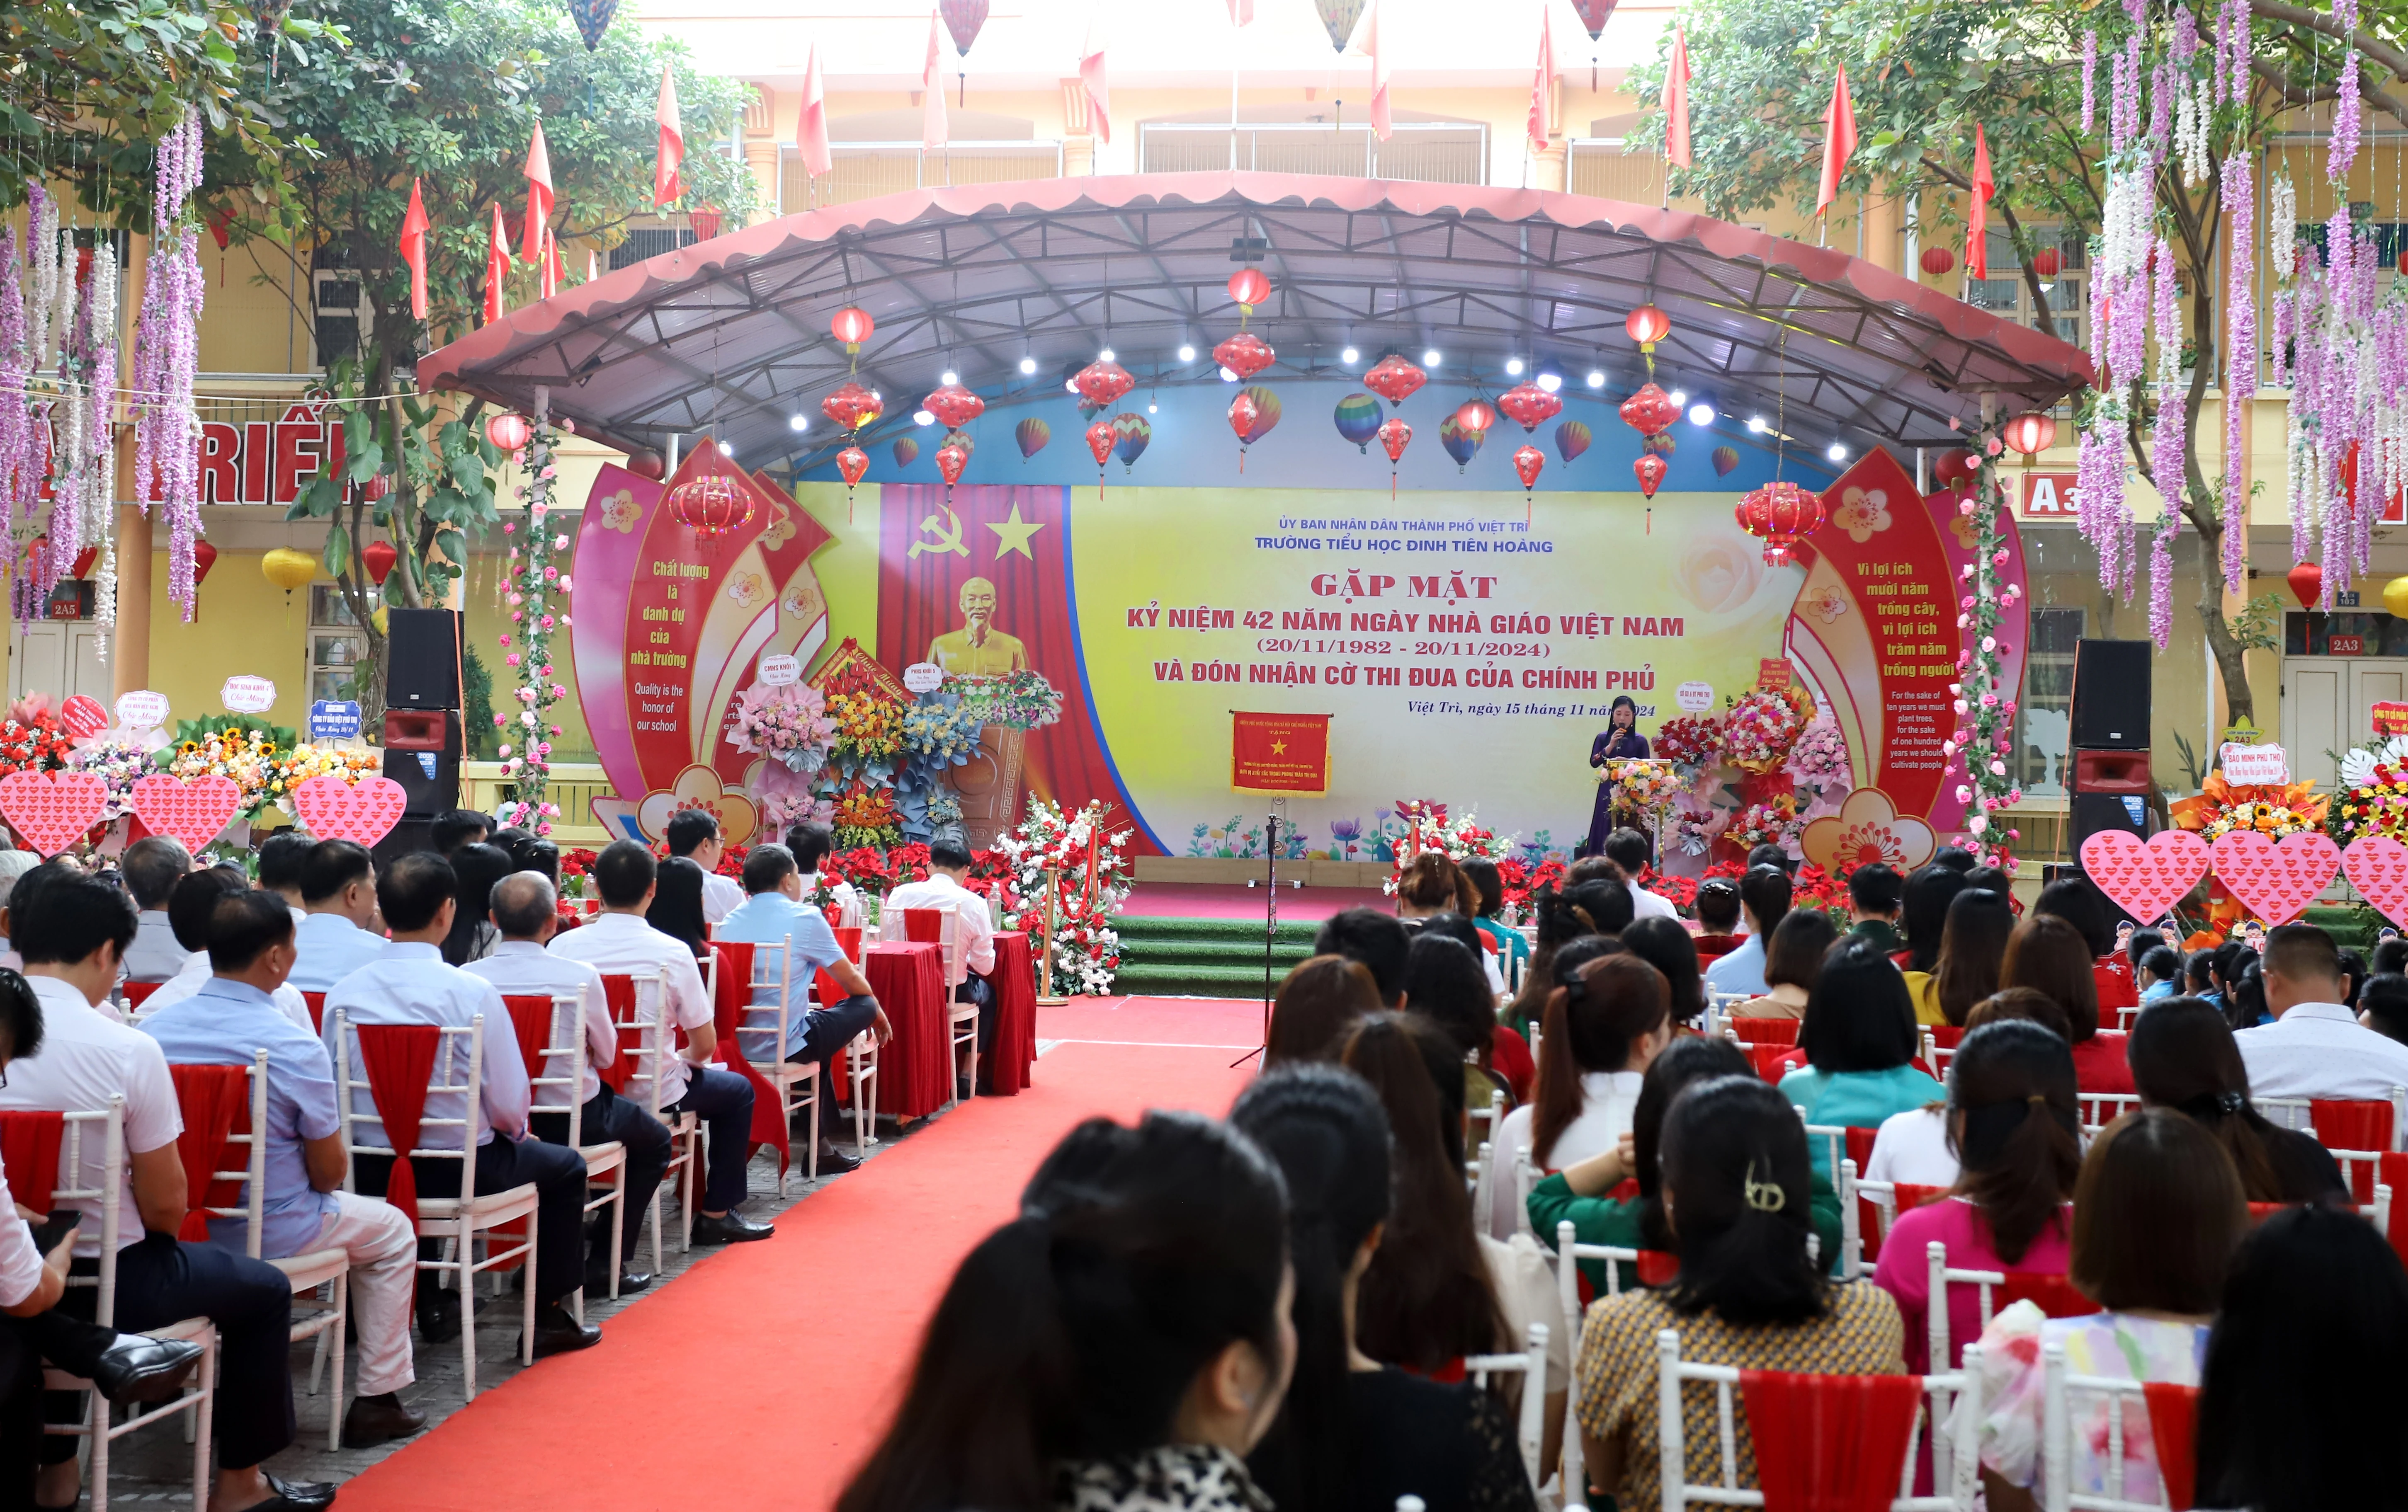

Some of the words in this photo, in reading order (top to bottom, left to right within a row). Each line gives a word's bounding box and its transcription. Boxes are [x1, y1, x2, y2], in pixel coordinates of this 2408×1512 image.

[1279, 515, 1297, 529] ỦY
[1301, 519, 1326, 529] BAN
[1330, 518, 1367, 530] NHÂN
[1370, 519, 1398, 531] DÂN
[1402, 519, 1444, 531] THÀNH
[1449, 518, 1475, 532] PHỐ
[1478, 520, 1505, 534] VIỆT
[1509, 520, 1528, 532] TRÌ
[1255, 535, 1321, 550] TRƯỜNG
[1326, 533, 1362, 550] TIỂU
[1368, 539, 1401, 554] HỌC
[1406, 540, 1447, 552] ĐINH
[1452, 538, 1488, 552] TIÊN
[1493, 538, 1553, 552] HOÀNG
[653, 559, 677, 577] Chất
[680, 562, 709, 580] lượng
[1857, 562, 1869, 576] Vì
[1873, 562, 1889, 578] lợi
[1893, 562, 1913, 575] ích
[668, 584, 677, 599] là
[1311, 568, 1396, 604] GẶP
[1407, 570, 1497, 606] MẶT
[1867, 581, 1898, 596] mười
[1901, 582, 1929, 595] năm
[54, 604, 75, 615] 2A5
[643, 606, 669, 621] danh
[672, 607, 685, 625] dự
[1877, 600, 1910, 617] trồng
[1914, 602, 1940, 616] cây,
[1127, 601, 1160, 628] KỶ
[1168, 605, 1234, 632] NIỆM
[1243, 611, 1274, 629] 42
[1282, 608, 1341, 631] NĂM
[1350, 610, 1420, 632] NGÀY
[1428, 611, 1481, 633] NHÀ
[1490, 611, 1551, 634] GIÁO
[1560, 612, 1614, 639] VIỆT
[1623, 617, 1684, 636] NAM
[650, 628, 669, 644] của
[1882, 622, 1893, 635] vì
[1898, 622, 1913, 638] lợi
[1918, 622, 1937, 635] ích
[1257, 638, 1391, 654] (20/11/1982
[1415, 642, 1551, 658] 20/11/2024)
[1887, 642, 1915, 656] trăm
[1920, 642, 1947, 655] năm
[2333, 640, 2359, 651] 2A3
[631, 650, 650, 666] nhà
[653, 649, 687, 669] trường
[780, 662, 791, 670] KHỐI
[1154, 659, 1184, 681] VÀ
[1191, 659, 1241, 682] ĐÓN
[1249, 661, 1316, 688] NHẬN
[1324, 662, 1358, 685] CỜ
[1364, 667, 1401, 686] THI
[1408, 668, 1457, 687] ĐUA
[1466, 661, 1514, 688] CỦA
[1522, 666, 1597, 689] CHÍNH
[1606, 663, 1655, 691] PHỦ
[1884, 662, 1916, 678] trồng
[1920, 662, 1955, 677] người
[635, 682, 661, 700] Quality
[663, 684, 669, 696] is
[672, 685, 683, 696] the
[1892, 691, 1903, 699] For
[1904, 691, 1915, 699] the
[1916, 691, 1932, 699] sake
[1933, 691, 1941, 699] of
[70, 698, 82, 708] CÔNG
[642, 700, 665, 714] honor
[666, 702, 674, 714] of
[1408, 701, 1435, 716] Việt
[1439, 702, 1463, 715] Trì,
[1468, 703, 1501, 717] ngày
[1505, 703, 1520, 714] 15
[1524, 703, 1566, 717] tháng
[1569, 704, 1584, 715] 11
[1898, 704, 1917, 712] years
[637, 721, 650, 731] our
[651, 720, 677, 732] school
[1898, 715, 1915, 724] plant
[1916, 715, 1935, 723] trees,
[1890, 750, 1908, 758] years
[1920, 749, 1943, 757] should
[1920, 761, 1942, 770] people
